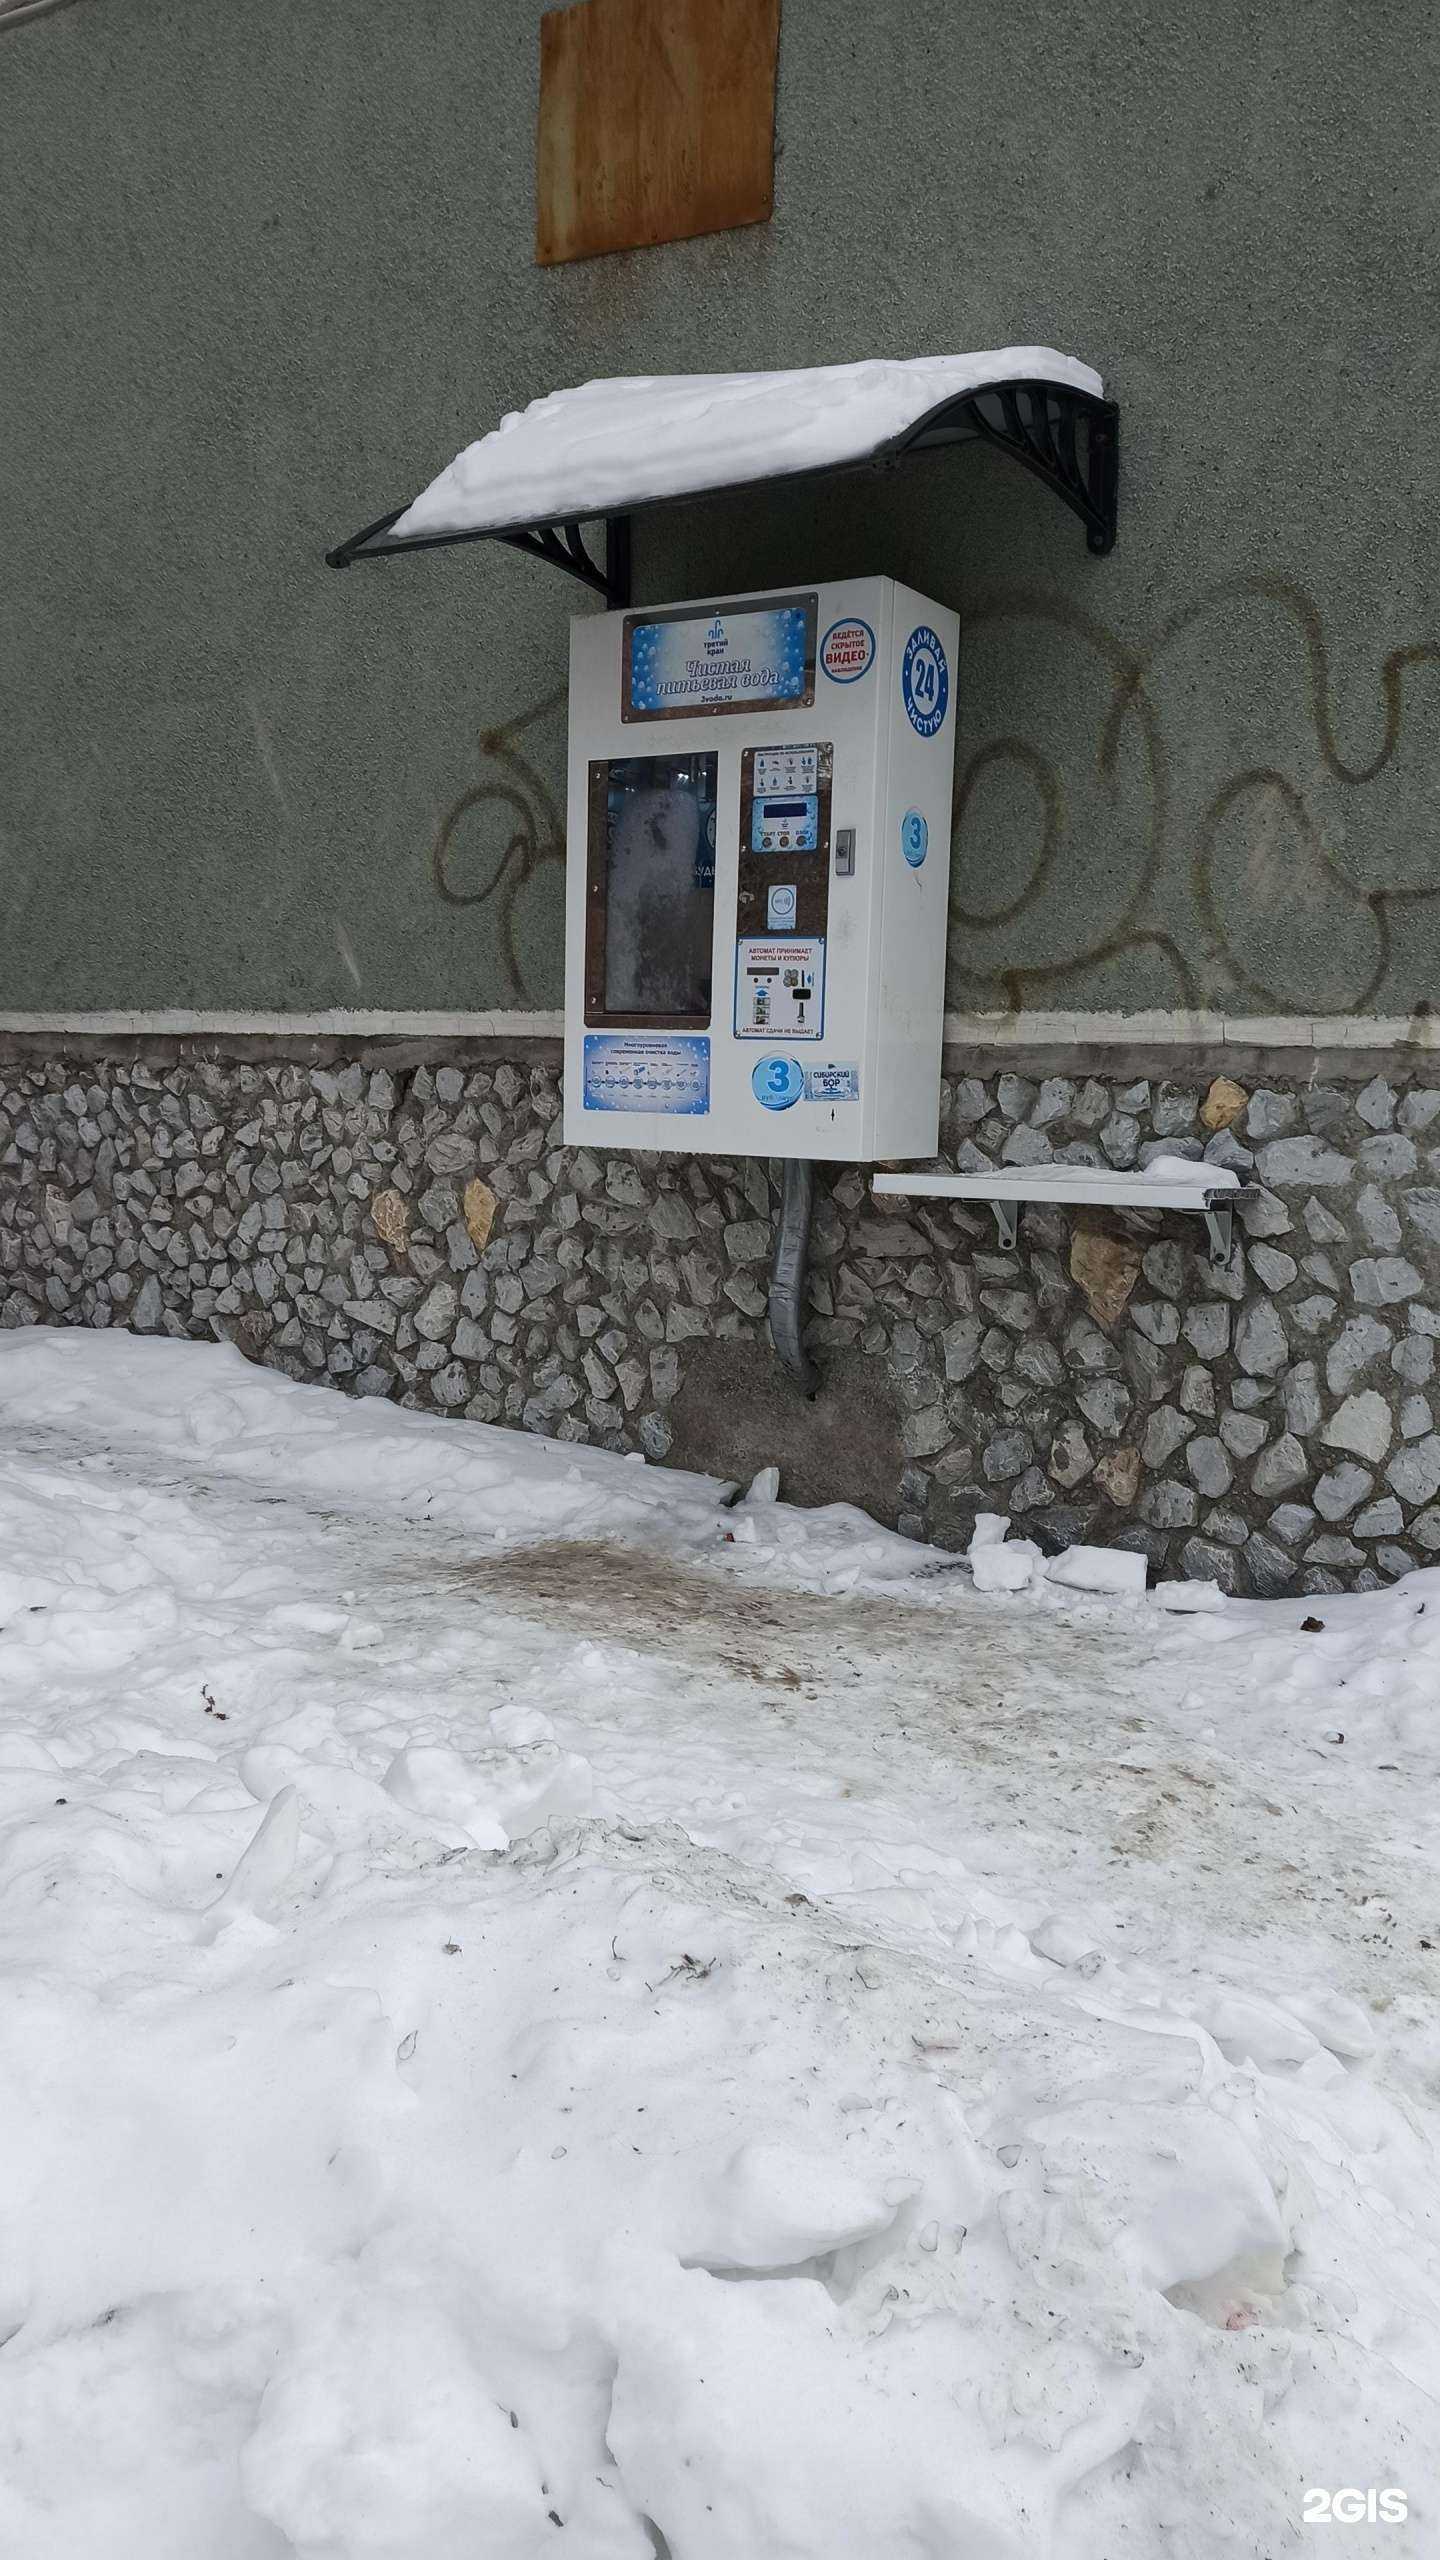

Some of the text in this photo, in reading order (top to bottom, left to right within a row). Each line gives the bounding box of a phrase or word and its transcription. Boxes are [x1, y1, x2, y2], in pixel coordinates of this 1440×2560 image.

[703, 638, 728, 649] третий
[707, 647, 724, 656] кран
[831, 640, 865, 650] СКРЫТОЕ
[906, 629, 947, 673] ЗАЛИВАЙ
[656, 667, 780, 696] питьевая вода
[685, 658, 751, 678] Чистая
[915, 658, 935, 702] 24
[907, 695, 942, 734] ЧИСТУЮ
[910, 817, 921, 849] 3
[767, 1060, 790, 1092] 3
[822, 1079, 841, 1088] БОР
